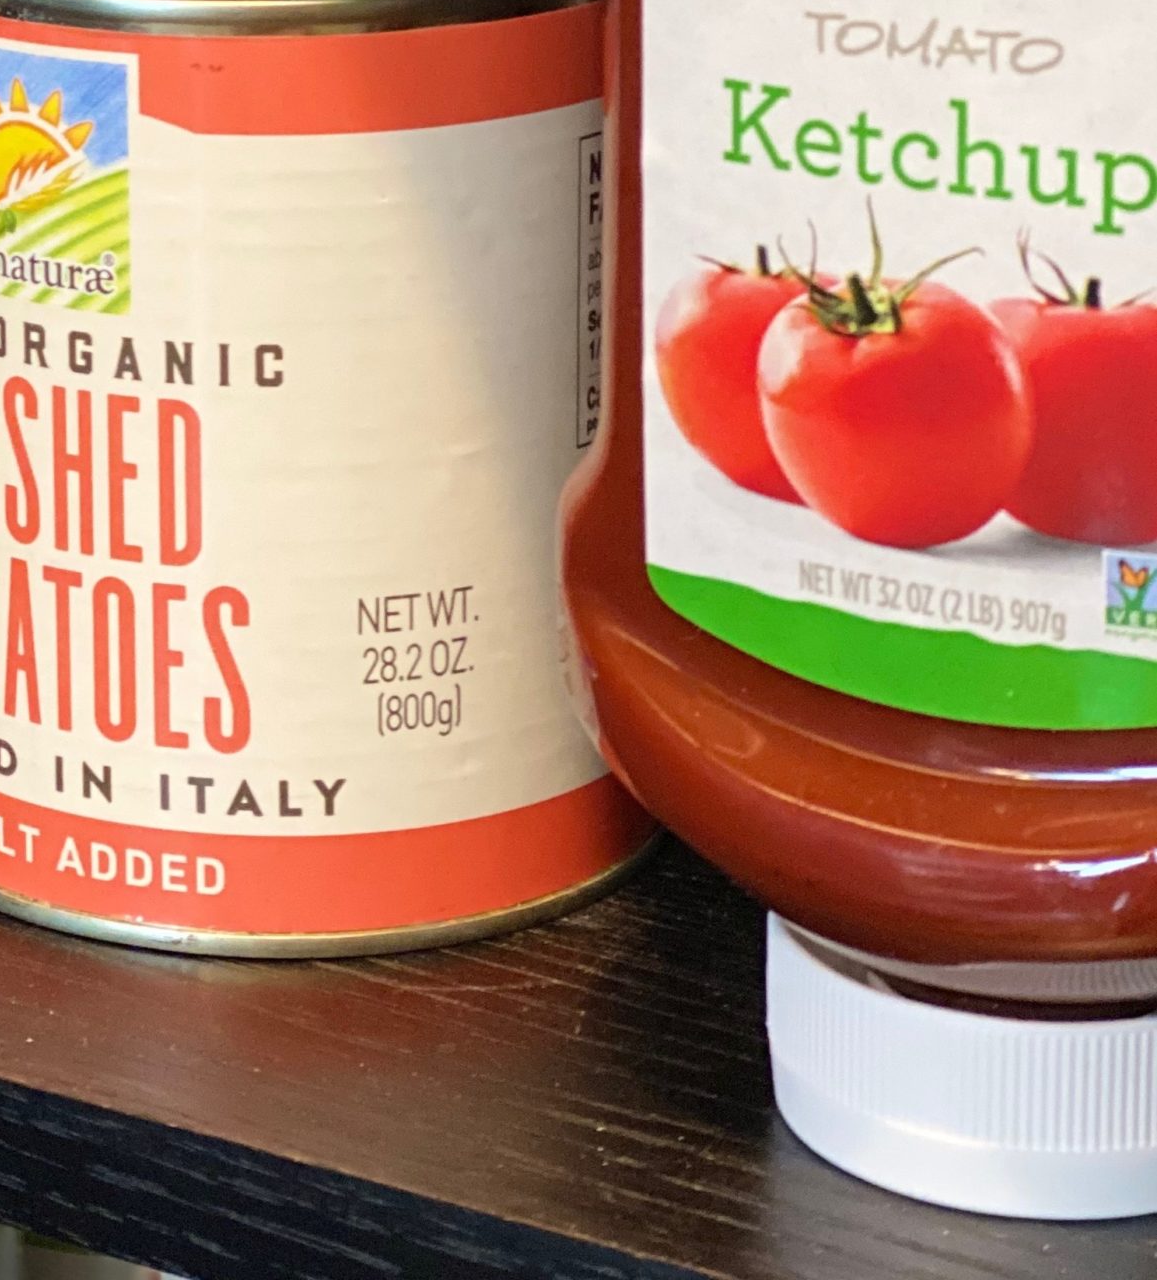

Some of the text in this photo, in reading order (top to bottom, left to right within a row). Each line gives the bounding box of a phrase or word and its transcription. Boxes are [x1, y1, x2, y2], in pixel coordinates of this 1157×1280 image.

[805, 11, 1064, 75] TOMATO
[723, 78, 1157, 236] Ketchup
[356, 584, 480, 636] NET WT.
[799, 559, 835, 594] NET
[841, 567, 875, 599] WT
[877, 573, 905, 607] 32
[906, 580, 936, 616] OZ
[940, 586, 962, 625] (2
[967, 592, 1004, 633] LB)
[1010, 598, 1067, 642] 907g
[362, 636, 475, 686] 28.2 OZ.
[377, 682, 463, 736] (800g)
[55, 755, 113, 803] IN
[160, 773, 347, 817] ITALY
[56, 835, 226, 896] ADDED
